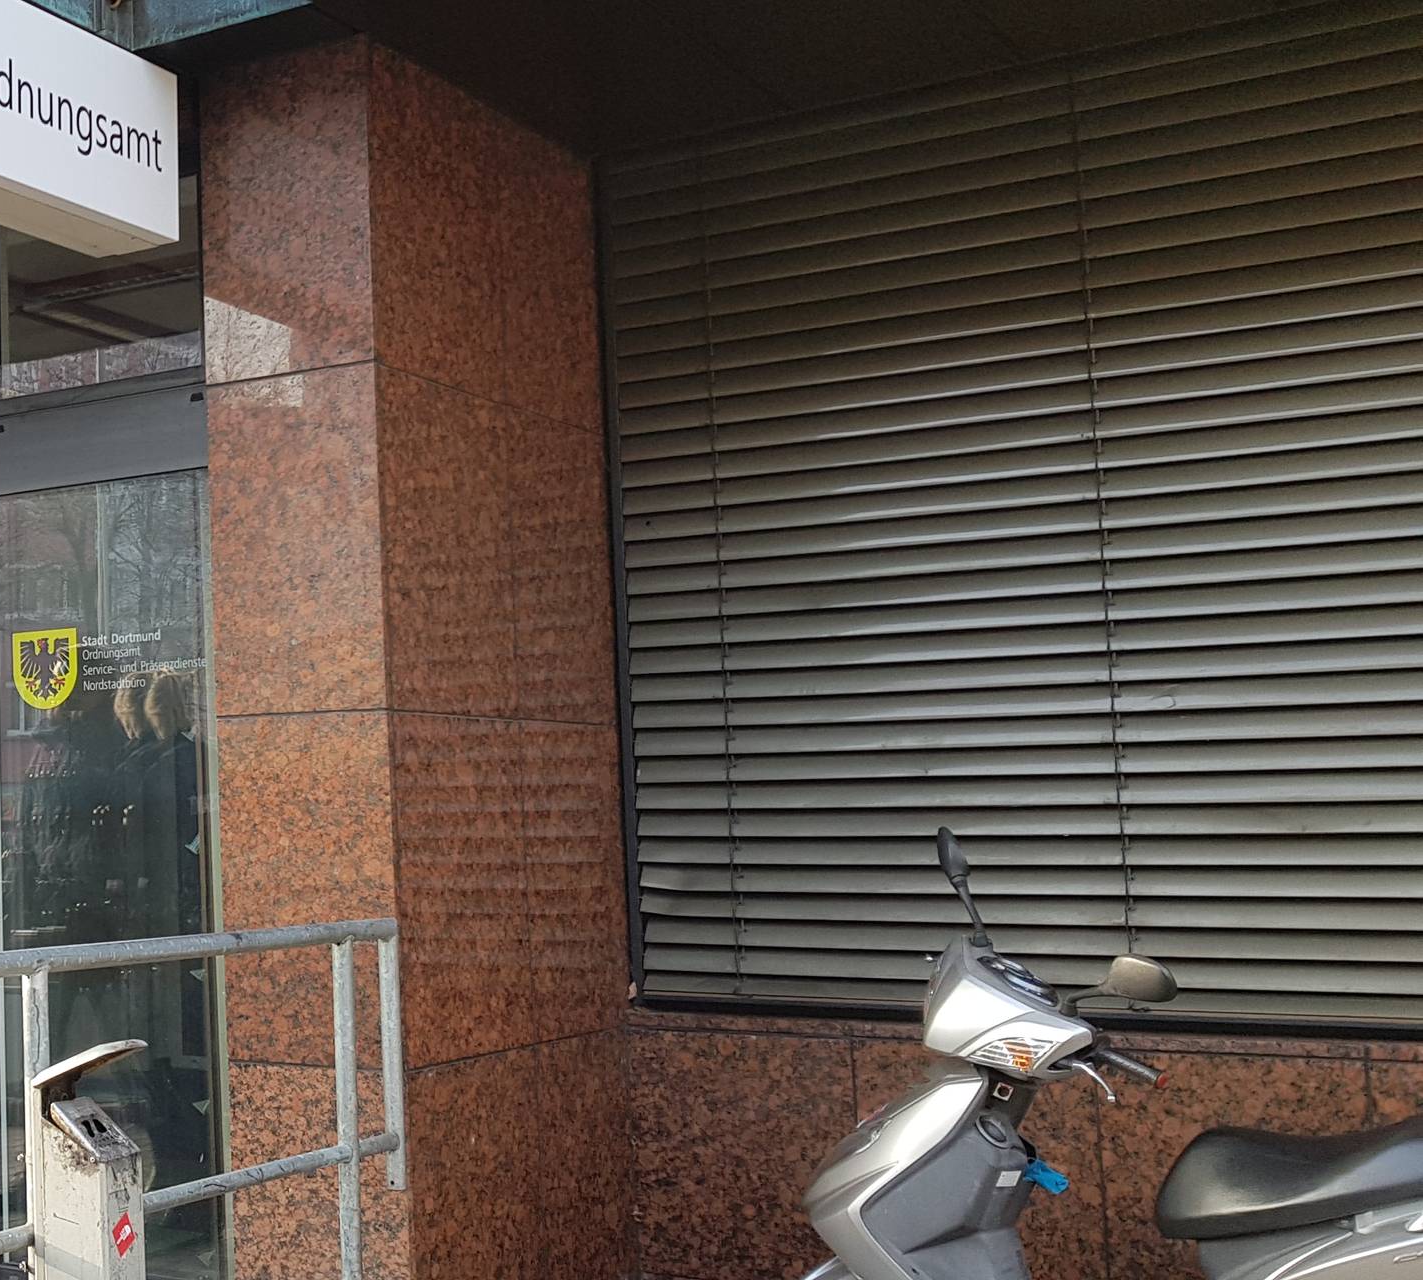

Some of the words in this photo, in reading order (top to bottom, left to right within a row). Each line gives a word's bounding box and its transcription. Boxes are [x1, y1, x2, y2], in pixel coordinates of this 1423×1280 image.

[81, 635, 108, 647] Stadt
[111, 629, 161, 644] Dortmund
[82, 646, 141, 661] Ordnungsamt
[82, 664, 117, 676] Service-
[119, 662, 137, 673] und
[82, 678, 146, 691] Nordstadtbüro
